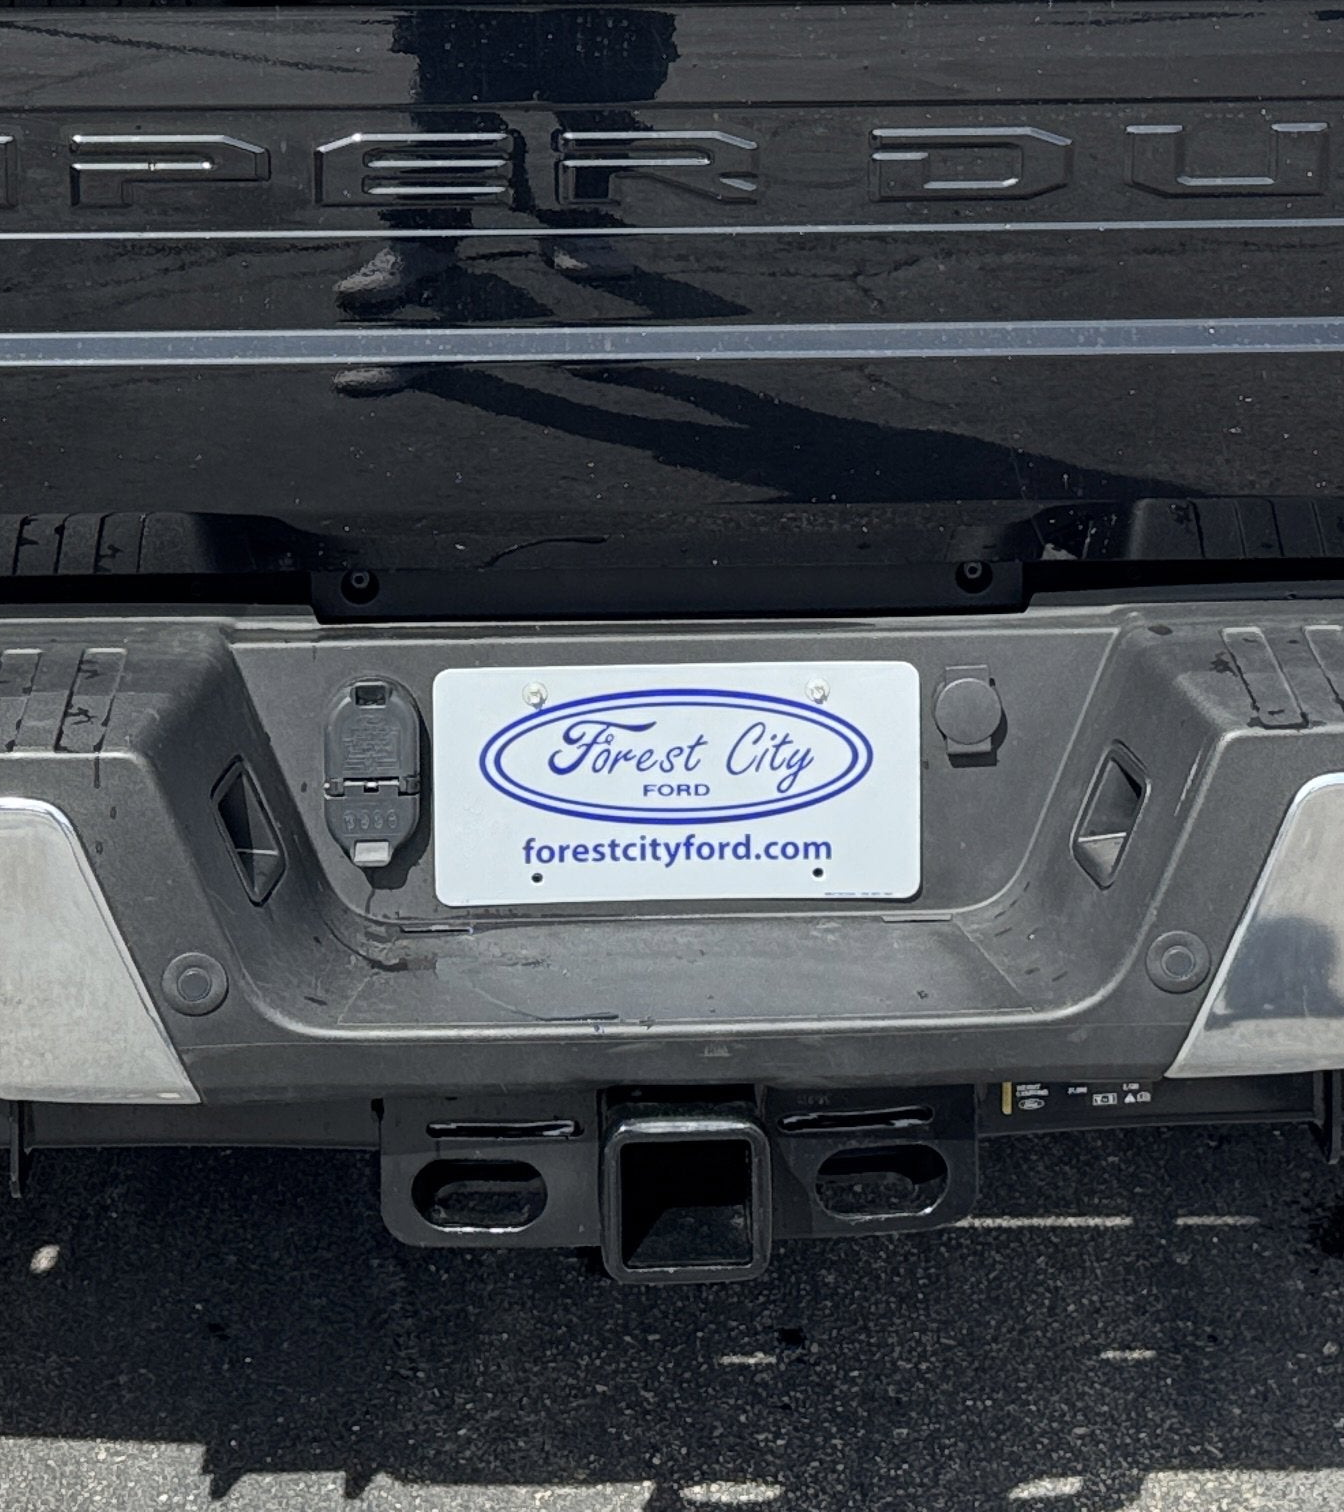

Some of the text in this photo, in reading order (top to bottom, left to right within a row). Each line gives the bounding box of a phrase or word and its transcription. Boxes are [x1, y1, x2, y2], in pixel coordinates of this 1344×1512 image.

[547, 720, 815, 794] Forest City
[642, 782, 711, 798] FORD
[522, 833, 833, 869] forestcityford.com
